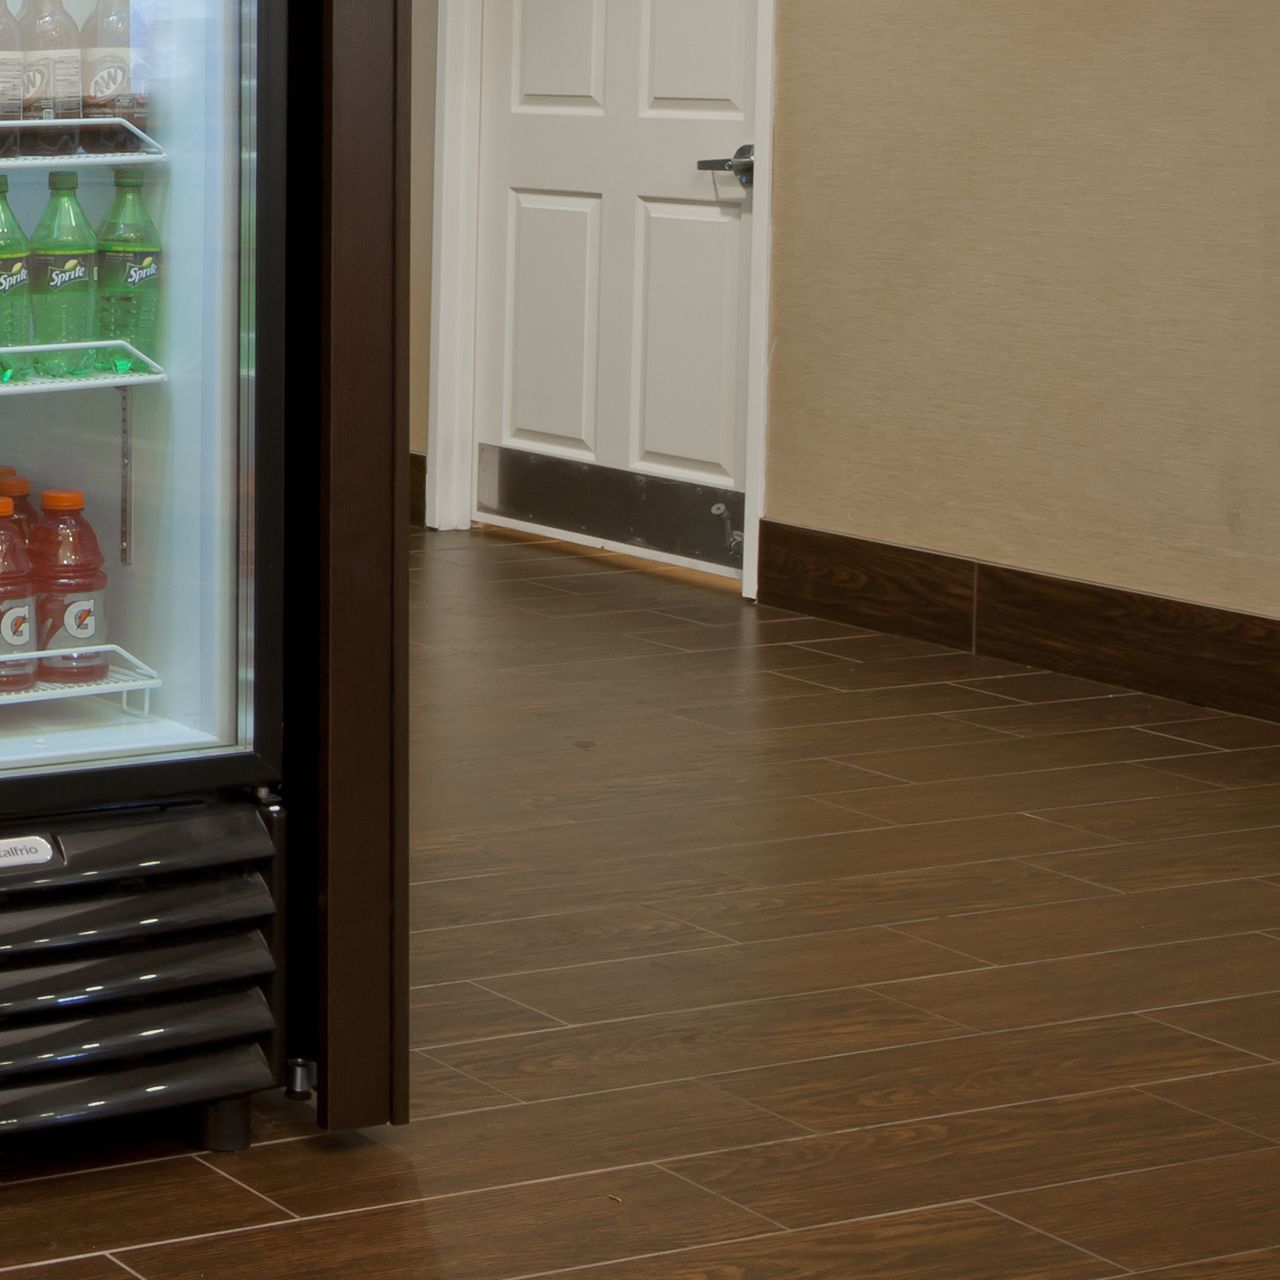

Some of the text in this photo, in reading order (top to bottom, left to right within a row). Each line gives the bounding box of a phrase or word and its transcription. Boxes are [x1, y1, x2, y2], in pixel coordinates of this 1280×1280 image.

[50, 264, 85, 287] Sprite
[0, 606, 30, 645] G
[64, 599, 95, 638] G
